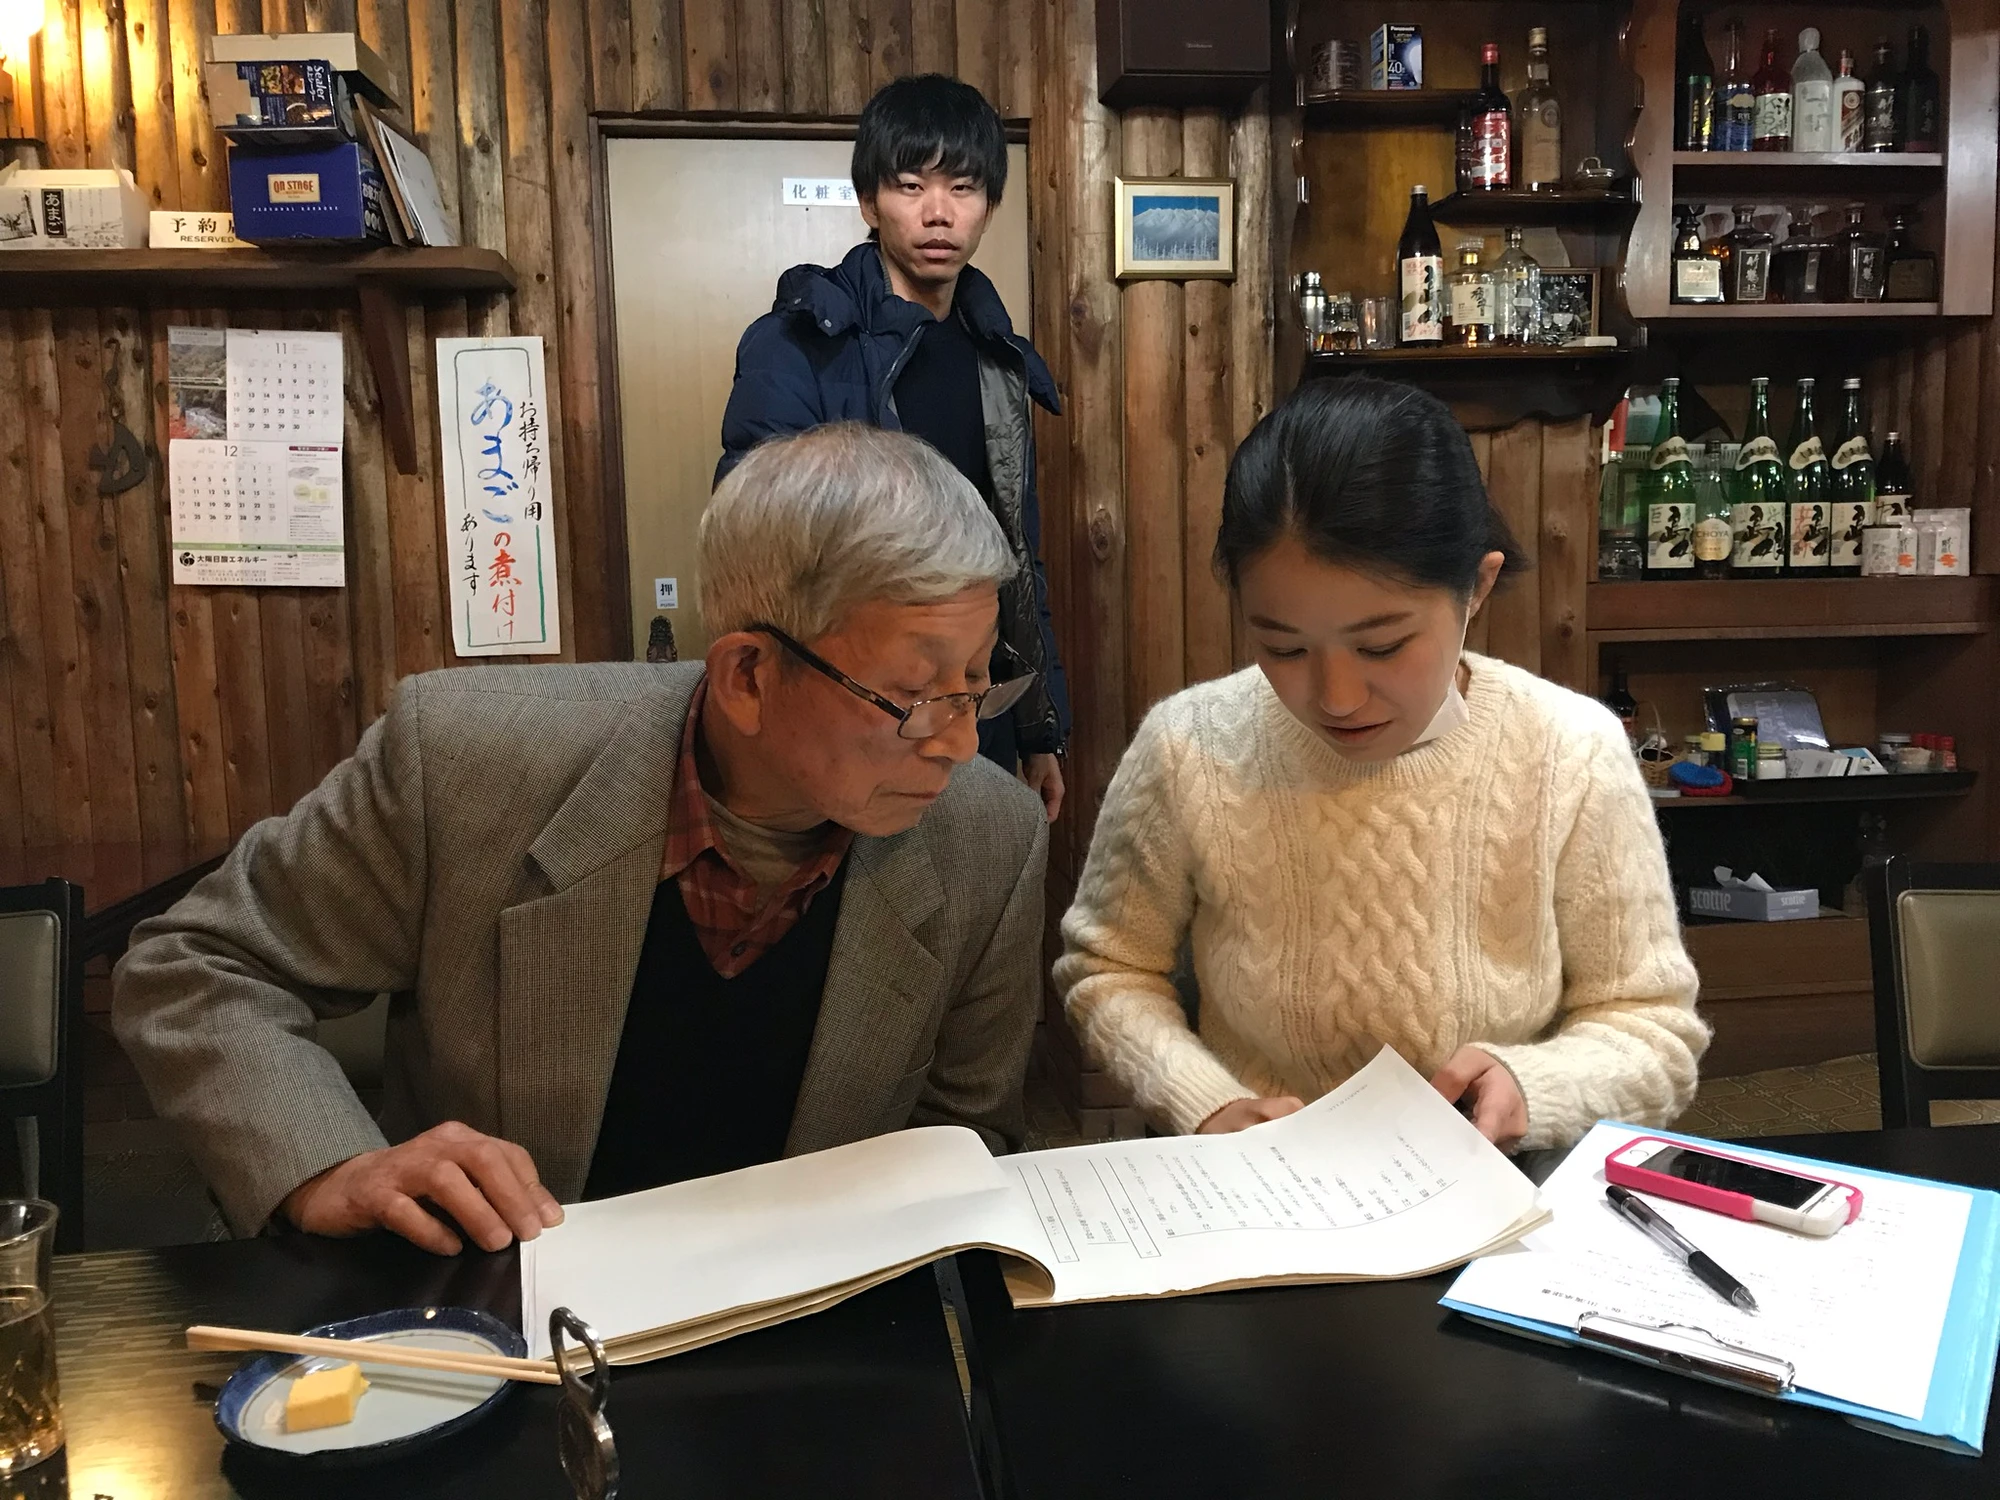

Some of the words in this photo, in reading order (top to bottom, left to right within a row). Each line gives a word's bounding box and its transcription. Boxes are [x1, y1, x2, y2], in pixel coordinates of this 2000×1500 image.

[1388, 61, 1402, 74] 40
[313, 65, 327, 100] Sealer
[273, 181, 285, 194] ON
[287, 180, 314, 193] STAGE
[792, 183, 853, 201] 化粧室
[45, 193, 63, 235] あまご
[172, 217, 235, 234] 予約
[180, 235, 235, 244] RESERVED
[518, 402, 541, 522] お持ち帰り用
[470, 376, 522, 642] あまごの煮付け
[1697, 530, 1730, 538] CHOYA
[197, 555, 267, 564] 大陽日酸エネルギー
[460, 513, 480, 596] あります
[660, 583, 673, 596] 押
[1689, 889, 1732, 912] scottie
